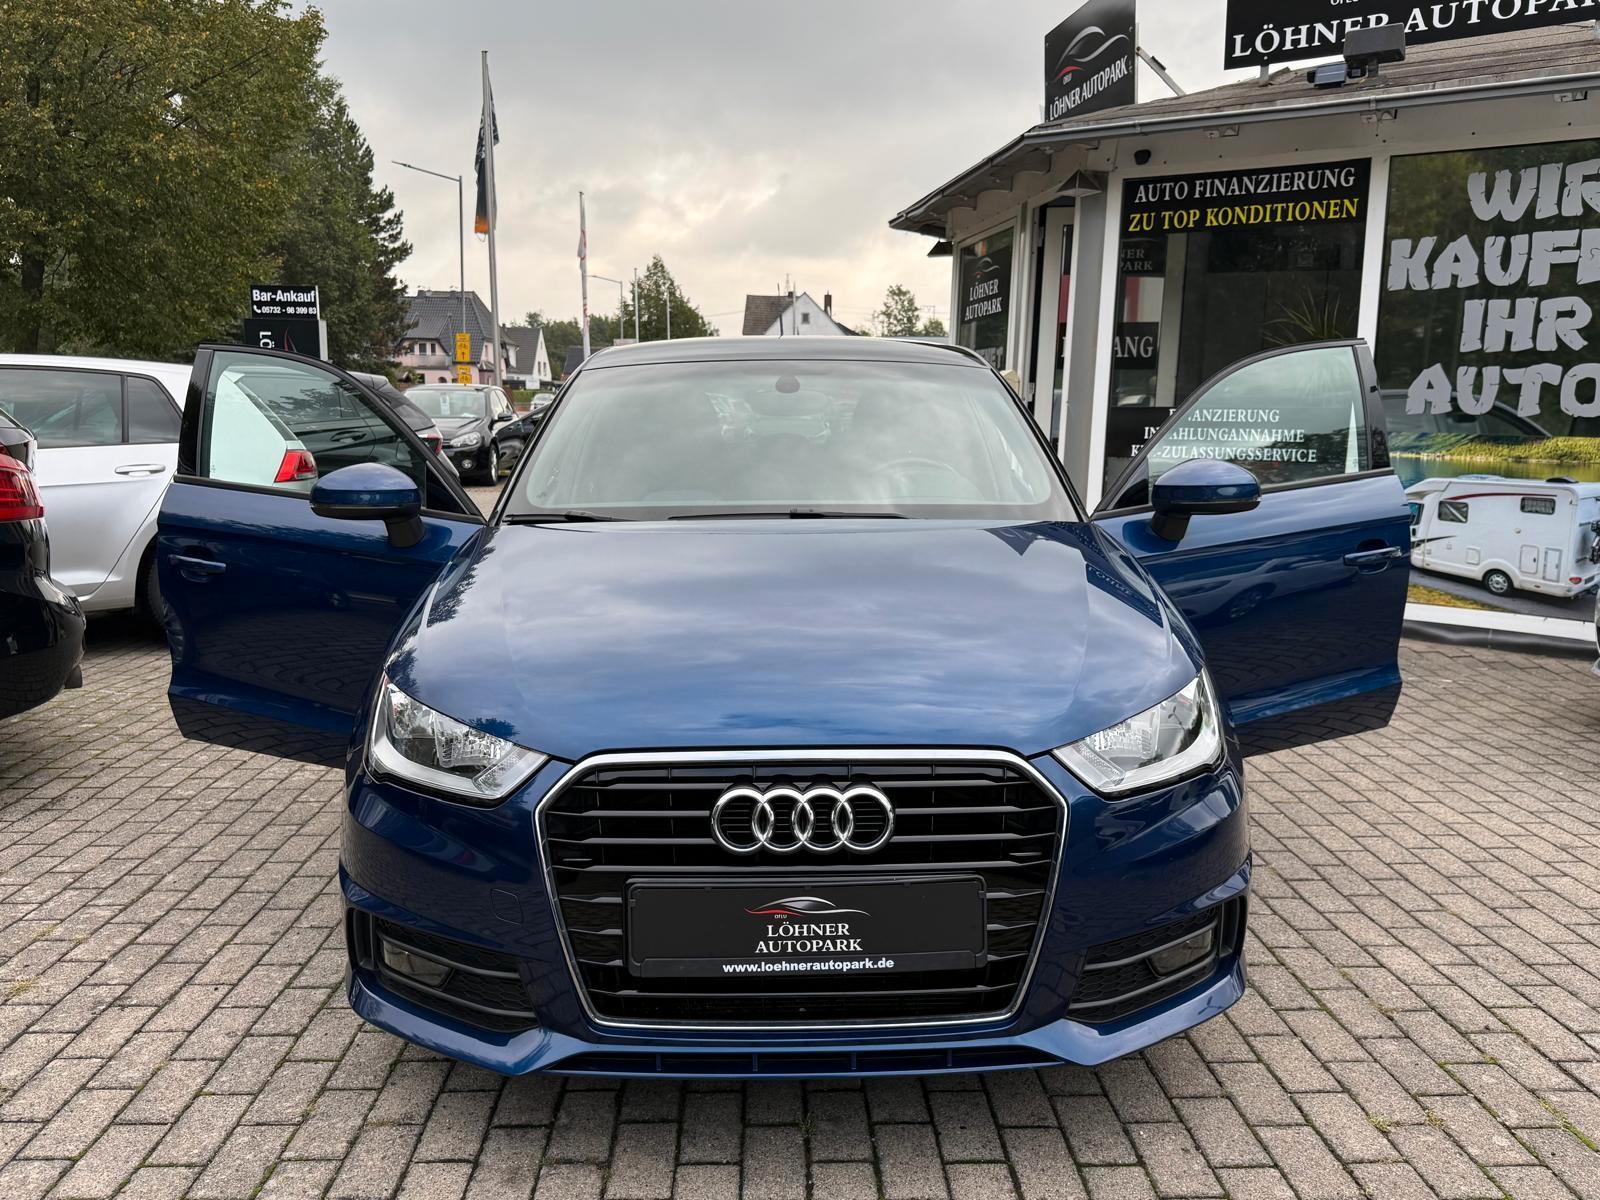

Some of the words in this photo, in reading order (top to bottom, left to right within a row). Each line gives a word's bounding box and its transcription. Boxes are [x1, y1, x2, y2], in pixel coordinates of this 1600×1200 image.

[1404, 0, 1600, 33] AUTOP
[1049, 87, 1081, 120] LÖHNER
[1081, 55, 1128, 102] AUTOPARK
[1134, 181, 1188, 203] AUTO
[1194, 167, 1355, 198] FINANZIERUNG
[1467, 159, 1600, 222] WIR
[1128, 213, 1155, 232] ZU
[1161, 209, 1200, 229] TOP
[1205, 198, 1359, 227] KONDITIONEN
[252, 289, 316, 302] Bar-Ankauf
[969, 279, 999, 301] LÖHNER
[262, 306, 281, 314] 05732
[296, 306, 308, 315] 399
[965, 297, 1002, 321] AUTOPARK
[1460, 296, 1592, 353] IHR
[1405, 362, 1600, 418] AUTO
[1169, 408, 1280, 422] ANZIERUNG
[1144, 426, 1305, 443] INHLUNGANNAHME
[1131, 444, 1317, 463] K-ZULASSUNGSSERVICE
[767, 921, 850, 937] LÖHNER
[755, 938, 863, 954] AUTOPARK
[722, 957, 895, 973] www.loehnerautopark.de
